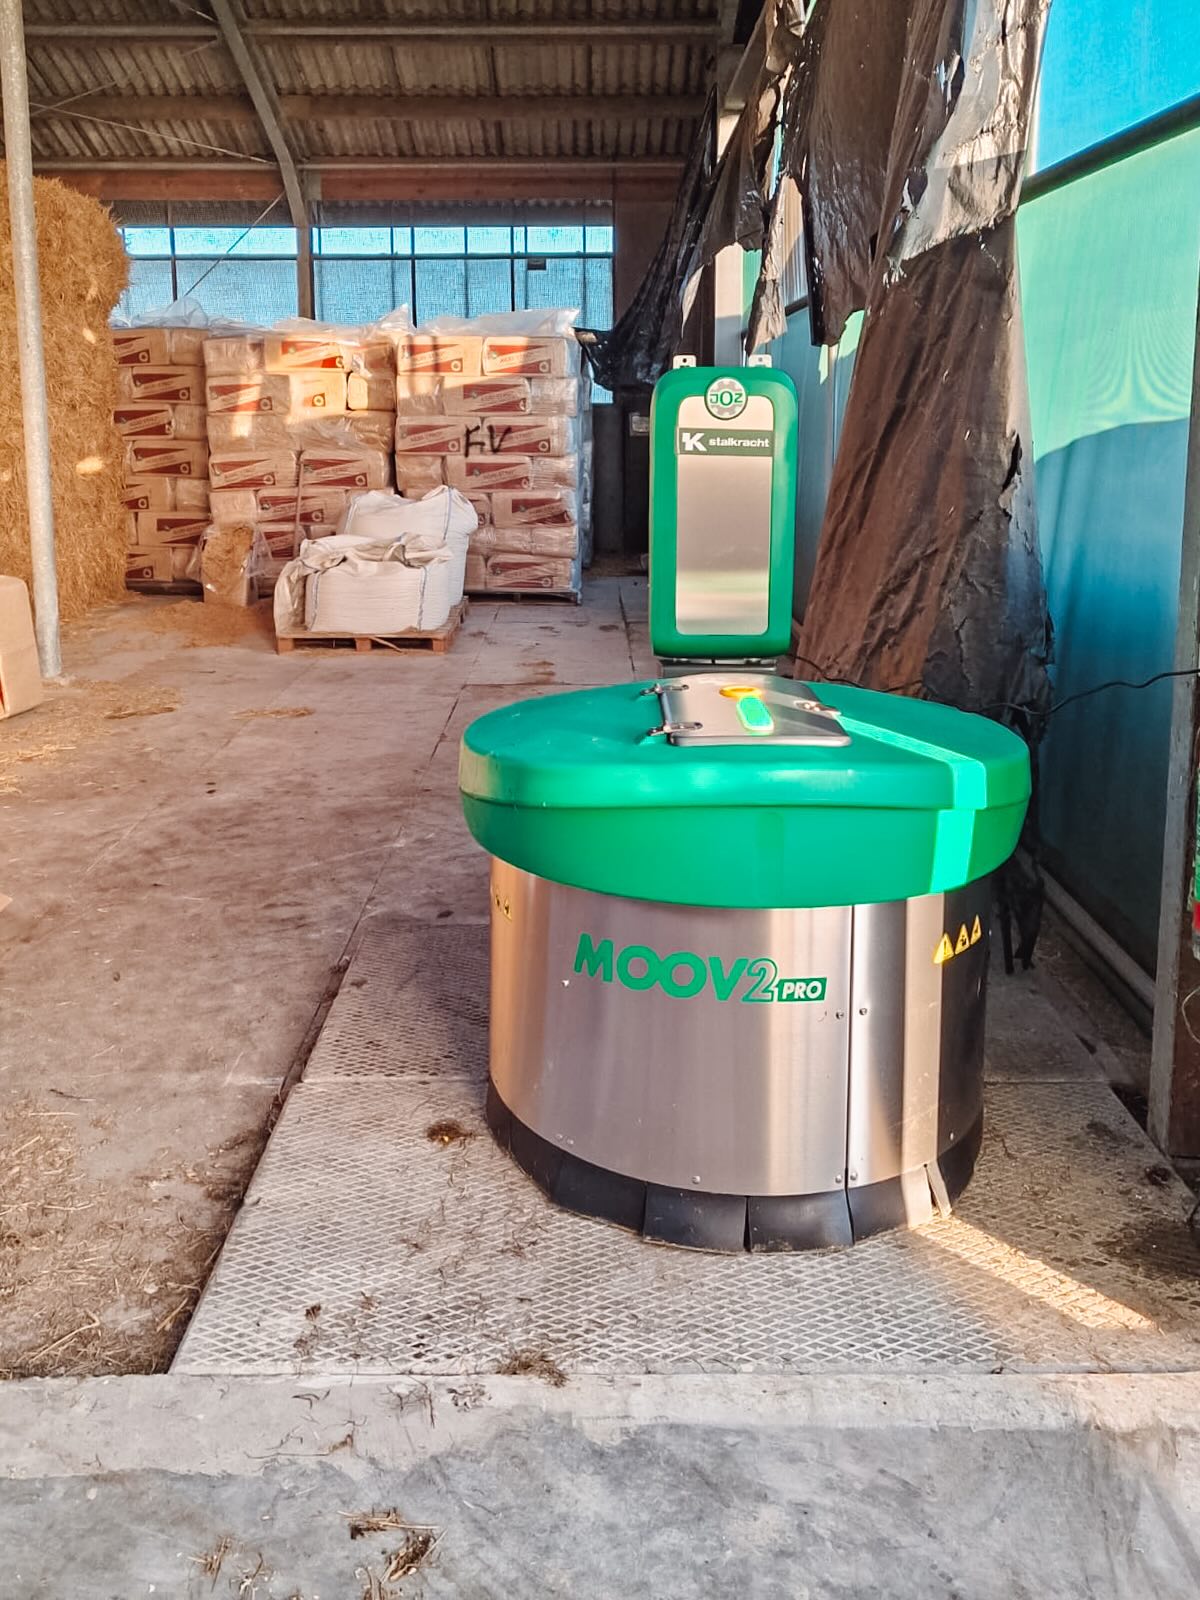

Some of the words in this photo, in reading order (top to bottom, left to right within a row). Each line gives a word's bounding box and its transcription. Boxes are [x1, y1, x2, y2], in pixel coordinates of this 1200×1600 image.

[709, 391, 744, 407] JOZ
[681, 432, 707, 452] K
[709, 436, 770, 448] stalkracht
[781, 980, 823, 1001] PRO
